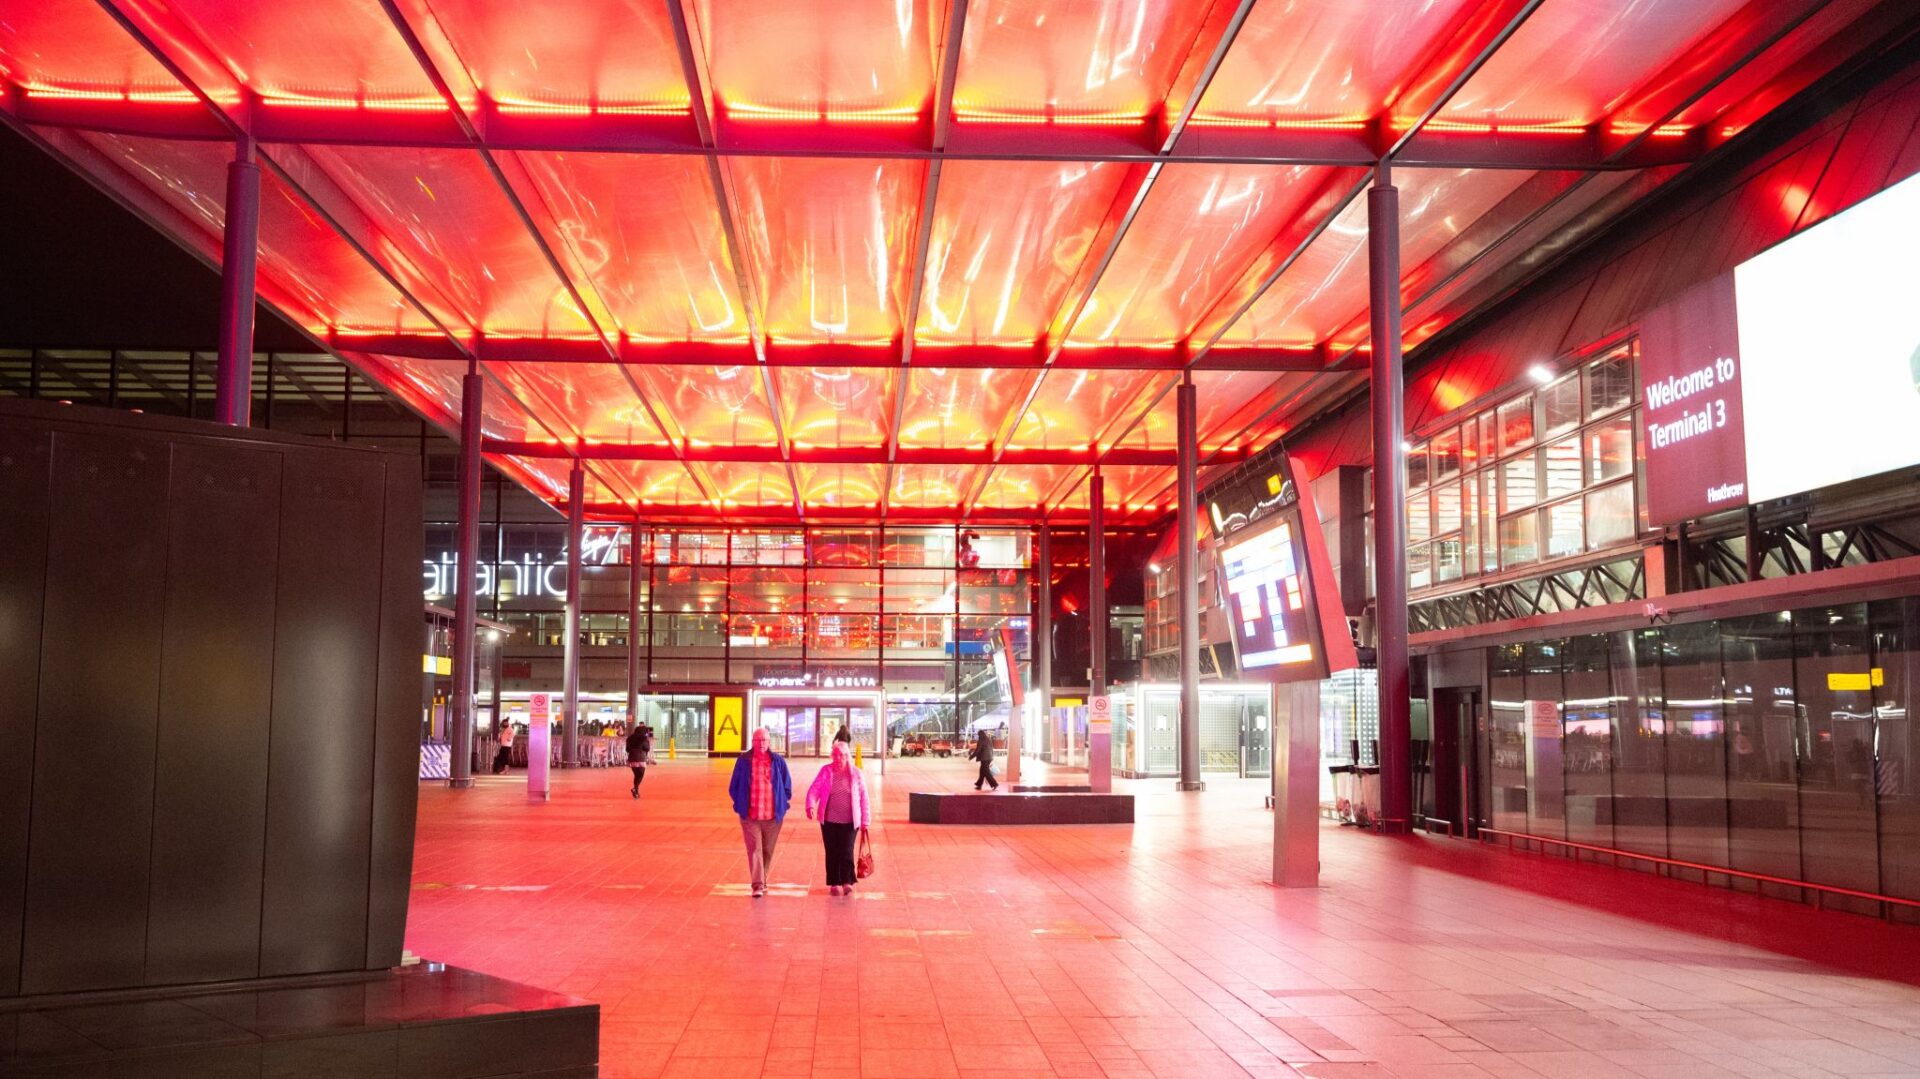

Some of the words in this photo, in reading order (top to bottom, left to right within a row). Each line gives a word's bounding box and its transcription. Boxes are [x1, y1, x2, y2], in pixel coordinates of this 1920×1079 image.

[1646, 366, 1714, 410] Welcome
[1716, 357, 1735, 383] to
[1648, 402, 1713, 450] Terminal
[1715, 398, 1727, 428] 3
[1707, 482, 1744, 503] Heathrow
[836, 677, 876, 687] DELTA
[717, 714, 739, 736] A
